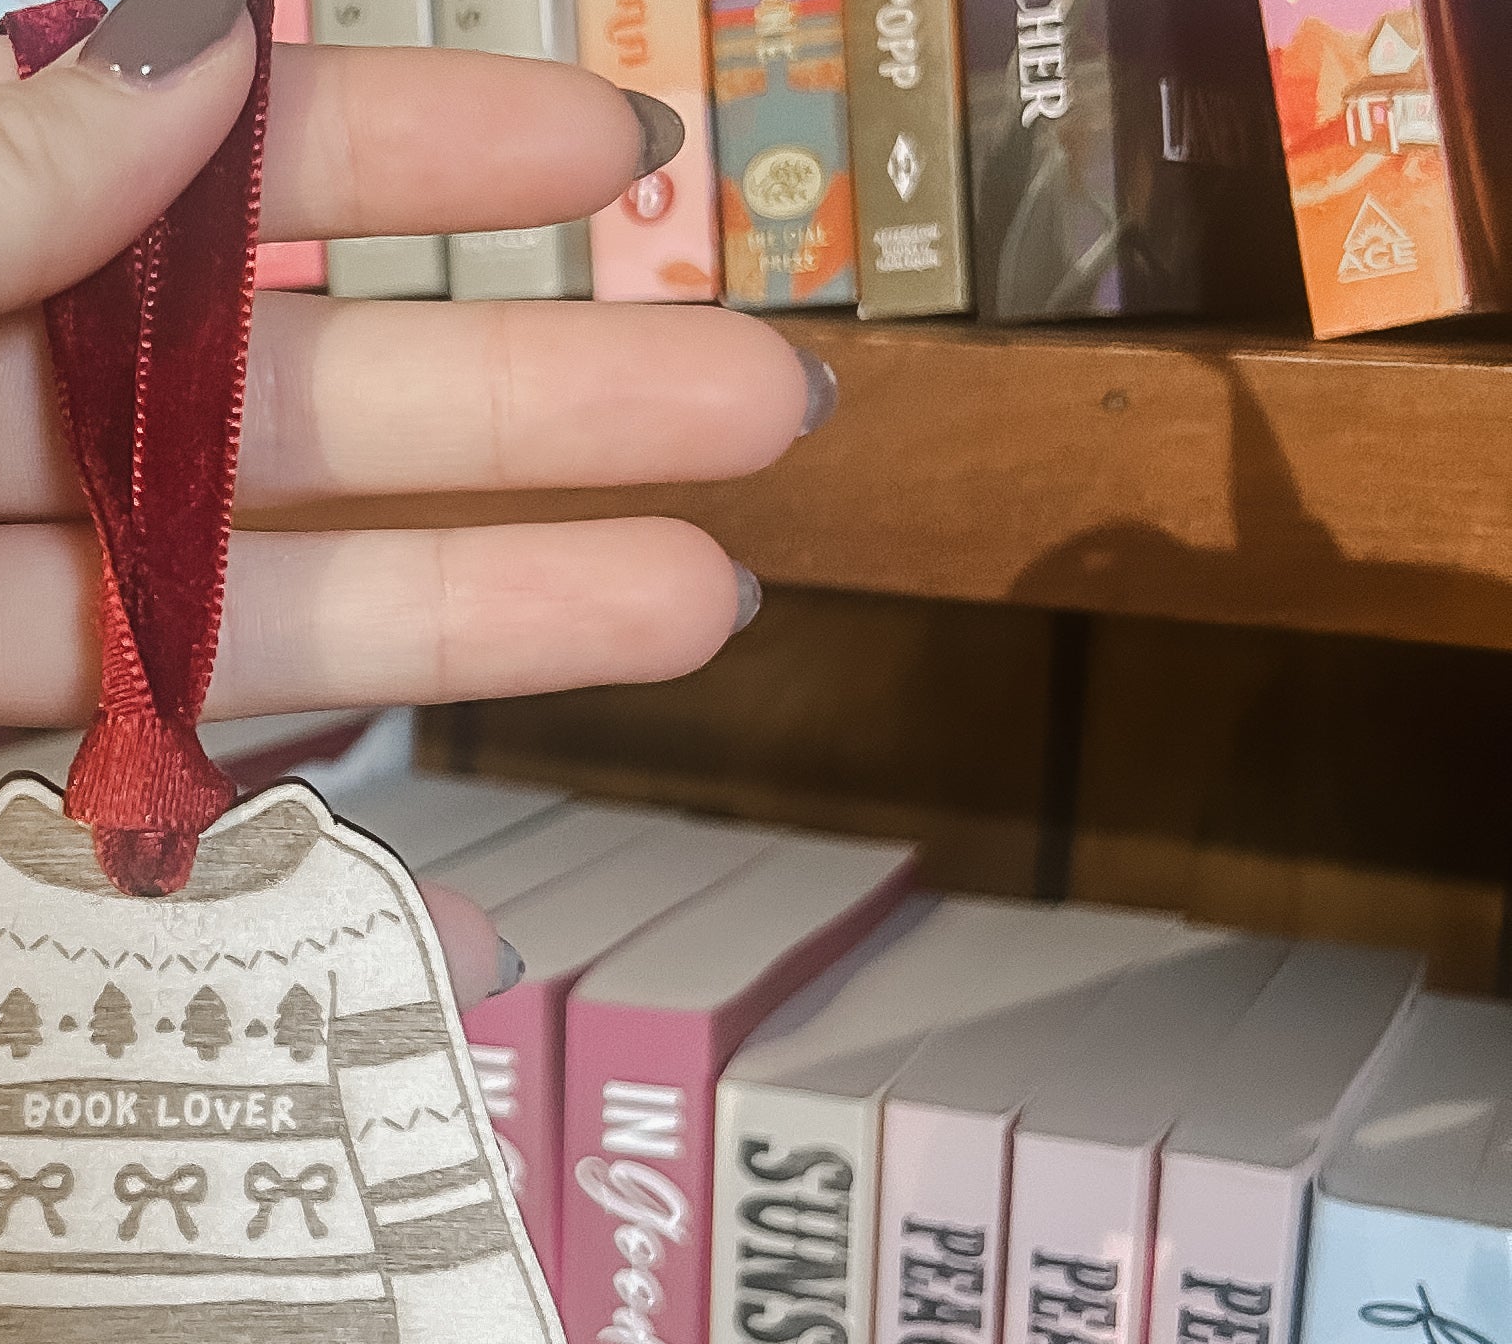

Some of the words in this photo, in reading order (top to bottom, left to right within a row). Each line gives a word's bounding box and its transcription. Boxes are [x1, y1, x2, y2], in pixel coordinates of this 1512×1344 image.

[23, 1088, 138, 1130] BOOK
[156, 1093, 296, 1133] LOVER
[601, 1081, 685, 1156] IN
